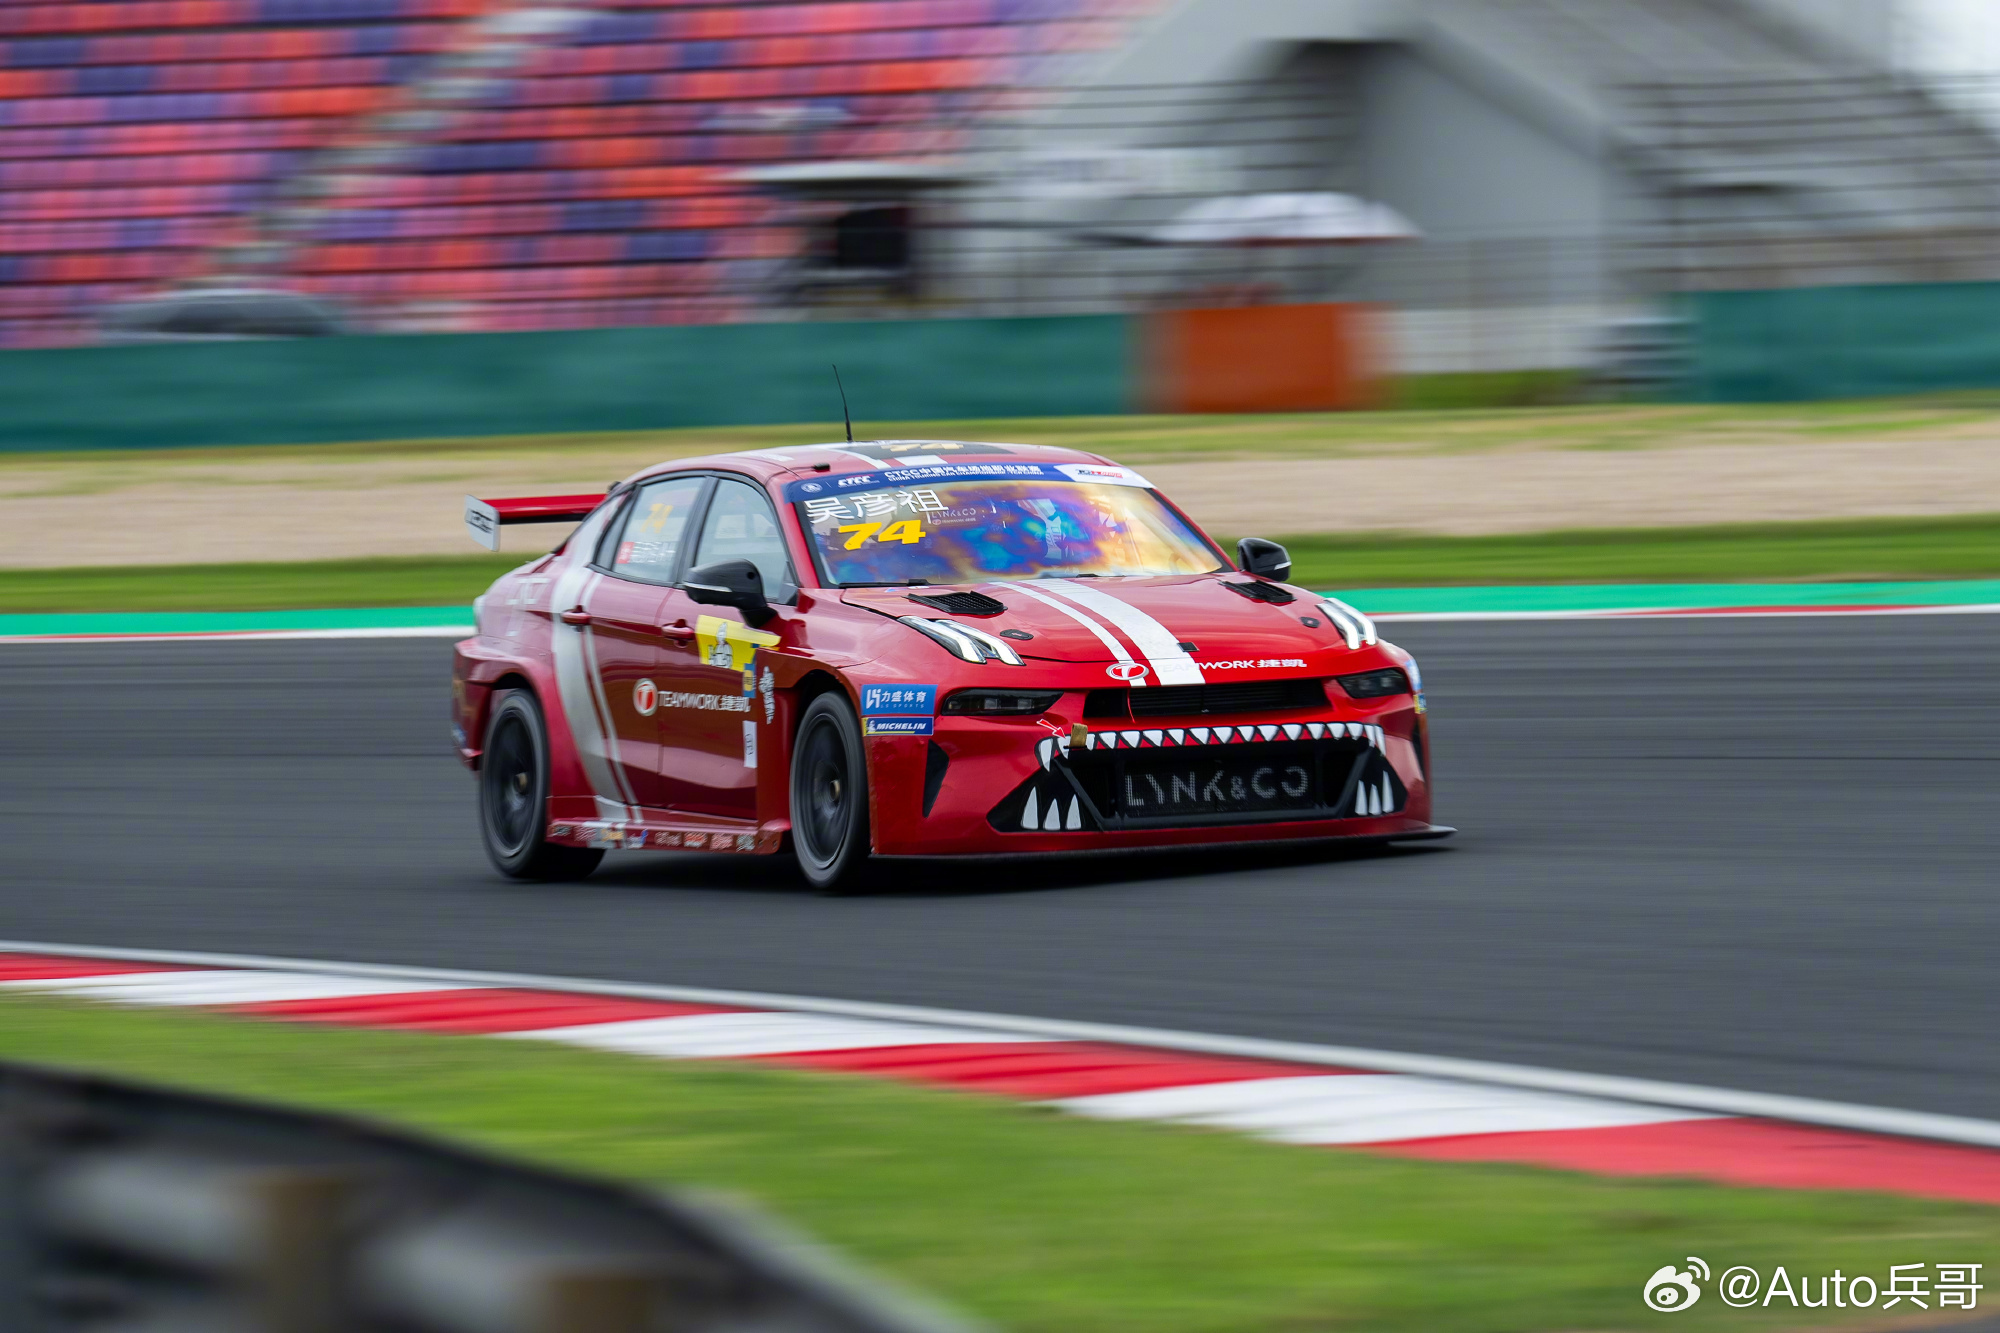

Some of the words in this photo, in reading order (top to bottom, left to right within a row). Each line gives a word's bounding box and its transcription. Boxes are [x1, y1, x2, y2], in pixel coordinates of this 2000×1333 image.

[803, 489, 949, 524] 吴彦祖
[838, 519, 926, 551] 74
[881, 690, 927, 703] 力盛体育
[876, 722, 927, 730] MICHELIN
